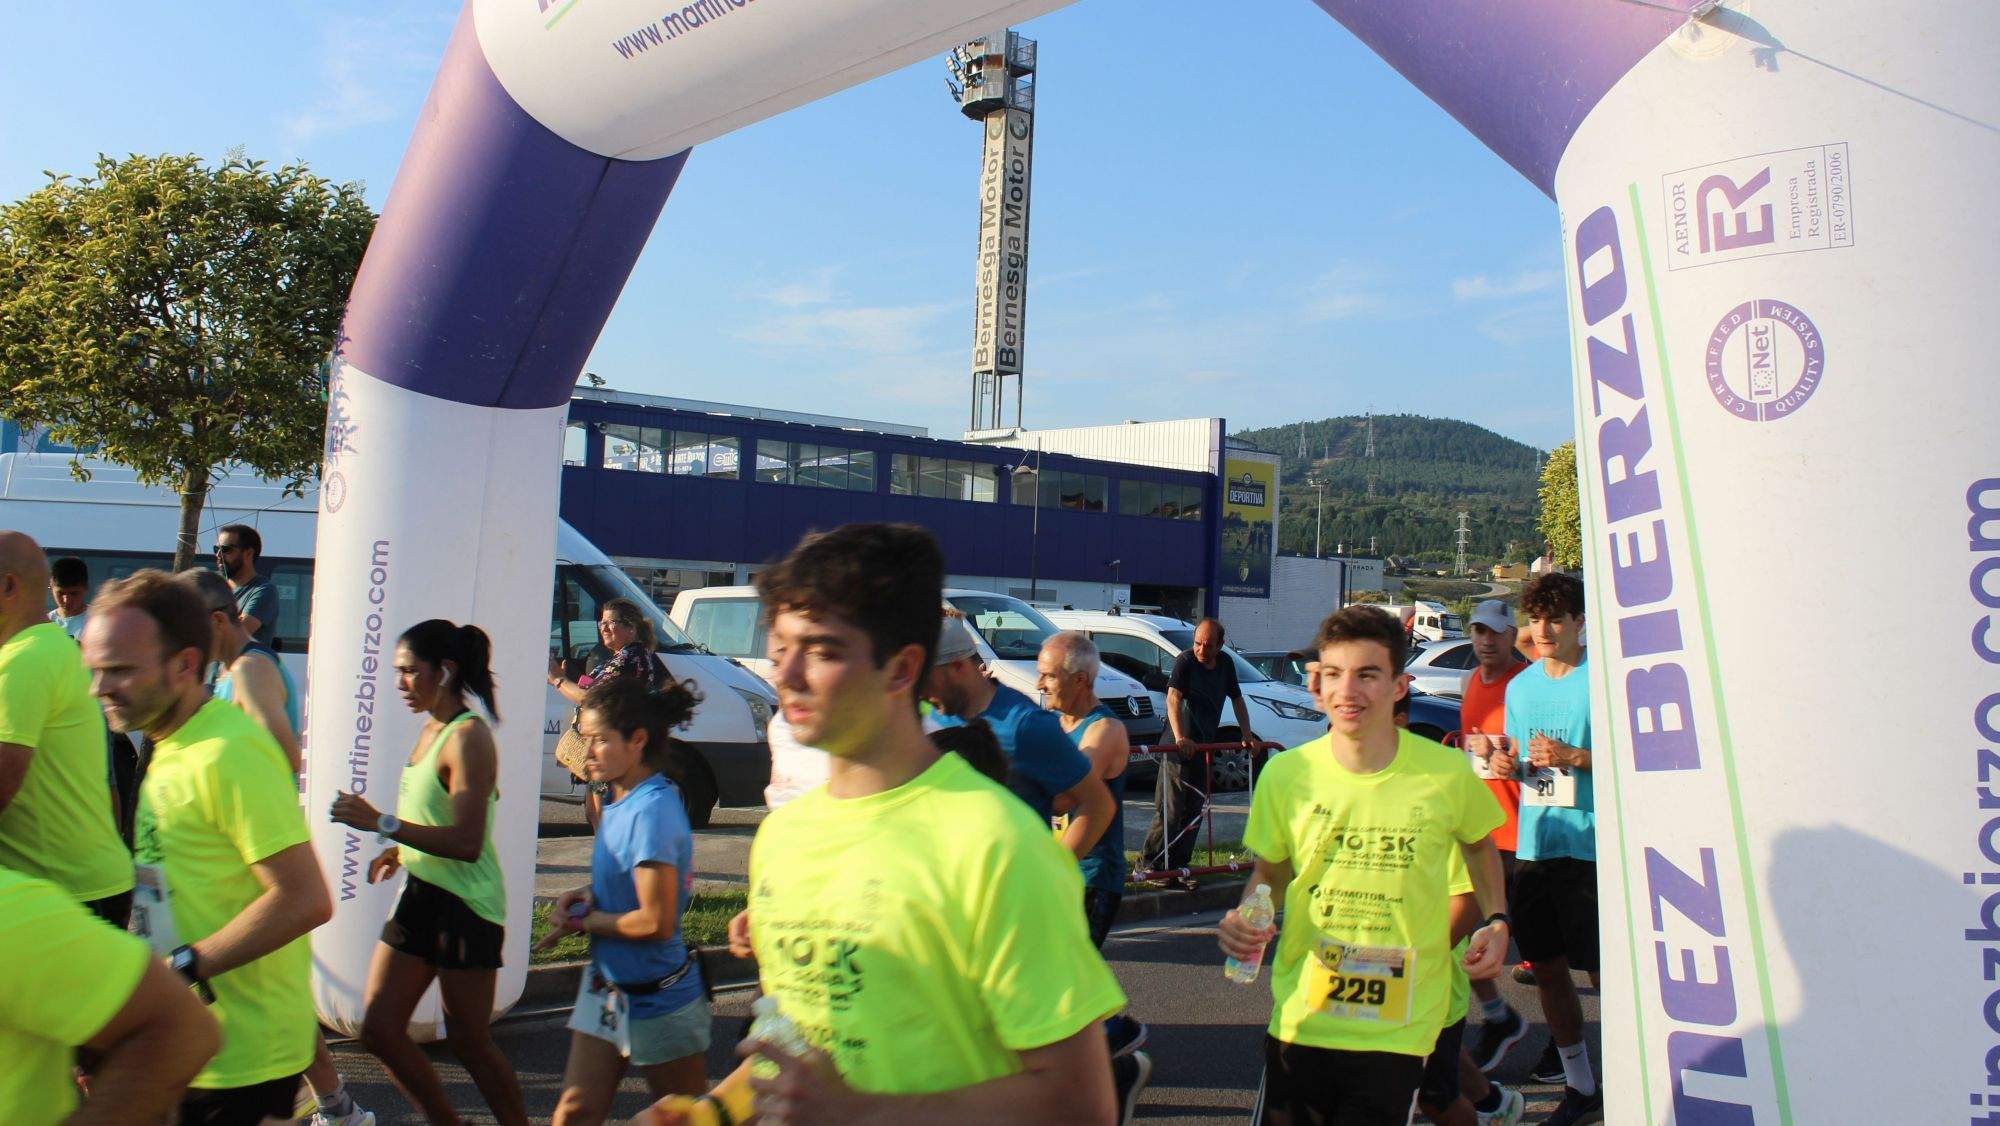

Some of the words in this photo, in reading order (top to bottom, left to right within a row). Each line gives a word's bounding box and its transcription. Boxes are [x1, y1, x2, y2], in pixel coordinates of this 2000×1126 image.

[983, 148, 999, 229] Motor
[1004, 146, 1024, 228] Motor
[1672, 181, 1690, 255] AENOR
[1789, 176, 1802, 240] Empresa
[1804, 160, 1823, 238] Registrada
[975, 235, 997, 367] Bernesga
[1000, 235, 1024, 367] Bernesga
[1770, 305, 1818, 349] SYSTEM
[1708, 313, 1746, 412] CERTIFIED
[1775, 357, 1819, 412] QUALITY
[1229, 489, 1264, 504] DEPORTIVA
[1575, 205, 1701, 773] BIERZO
[340, 539, 390, 901] wwwartinezbierzo.com
[1327, 974, 1386, 1006] 229
